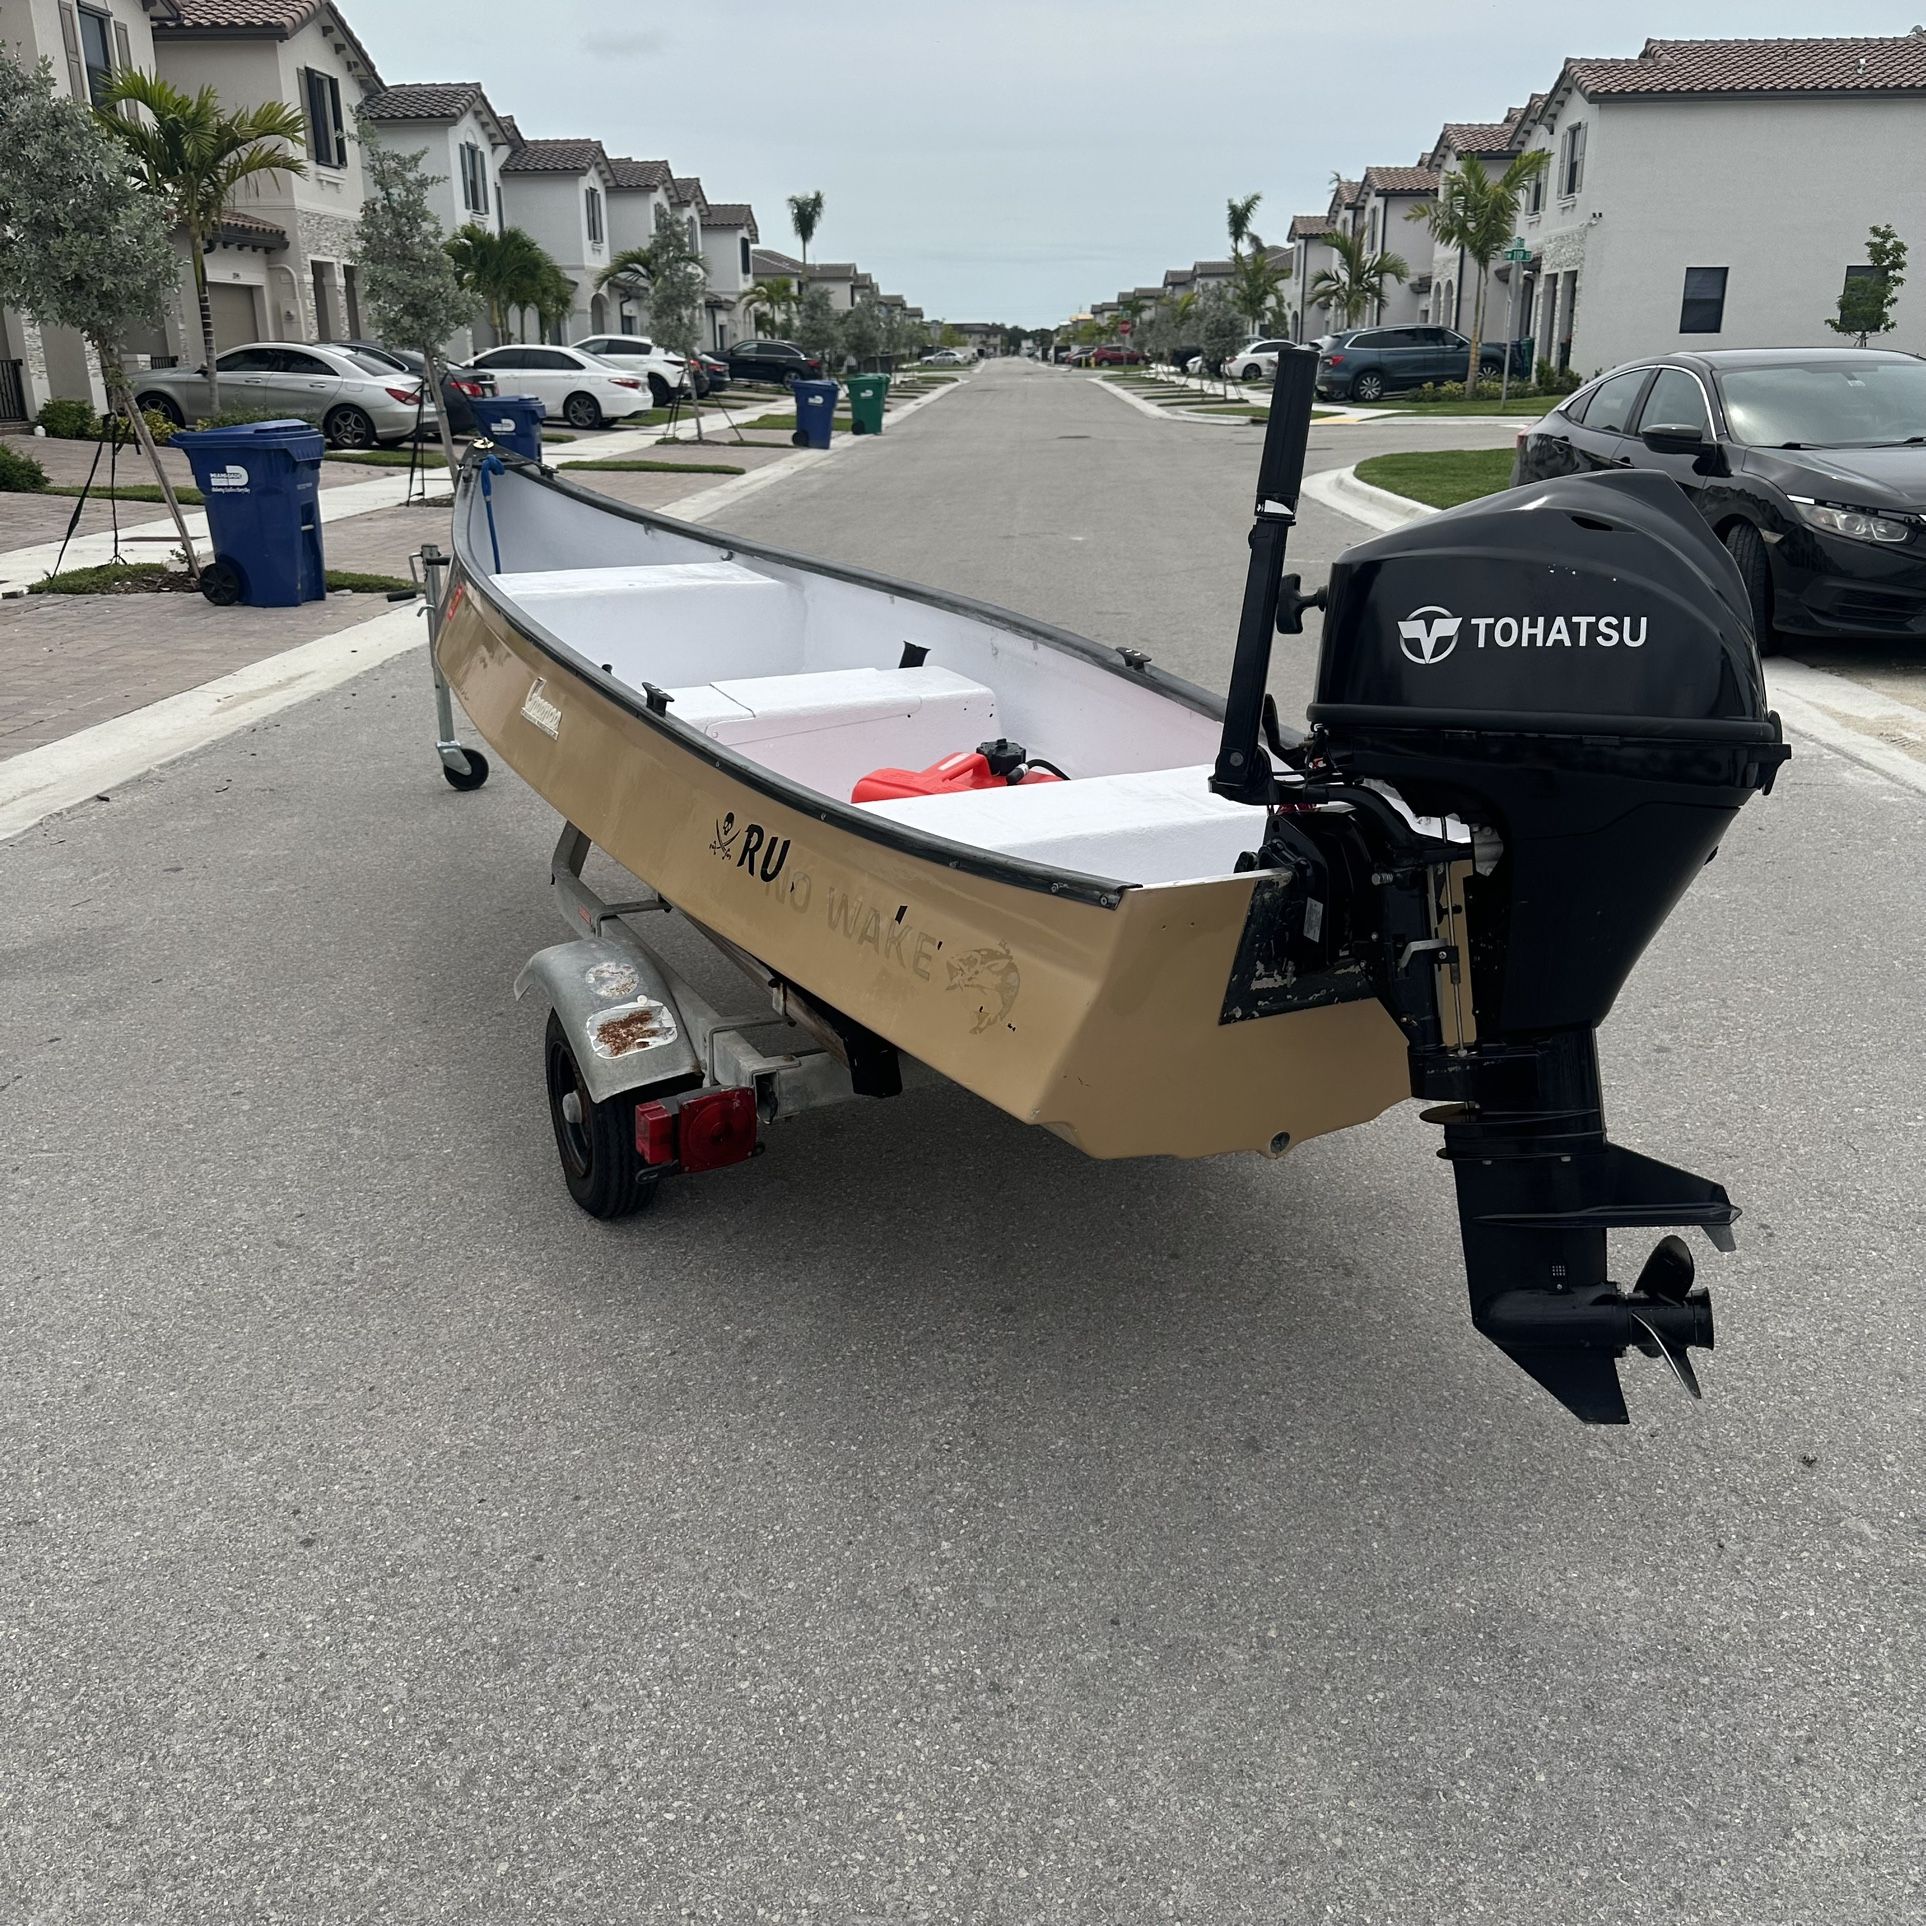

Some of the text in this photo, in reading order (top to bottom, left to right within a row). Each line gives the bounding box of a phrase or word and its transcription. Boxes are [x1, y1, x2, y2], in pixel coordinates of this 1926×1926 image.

[1470, 616, 1648, 648] TOHATSU
[736, 823, 791, 883] RU
[827, 886, 938, 982] WAKE
